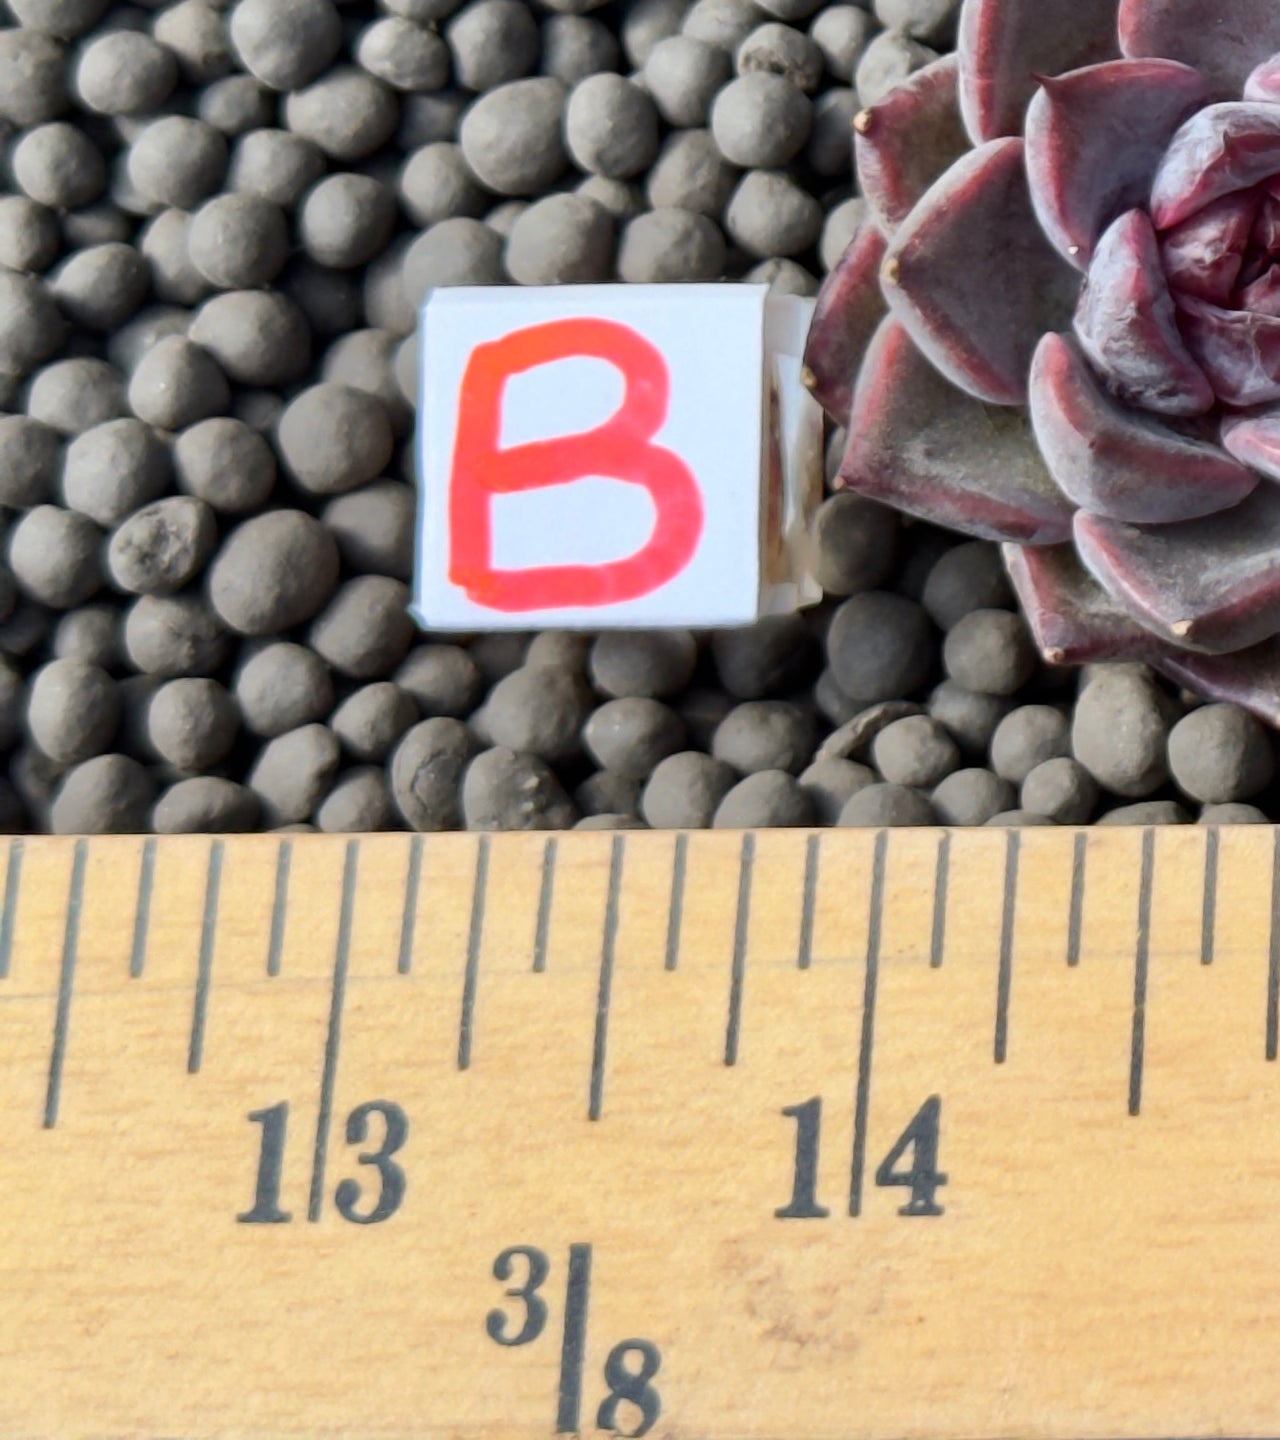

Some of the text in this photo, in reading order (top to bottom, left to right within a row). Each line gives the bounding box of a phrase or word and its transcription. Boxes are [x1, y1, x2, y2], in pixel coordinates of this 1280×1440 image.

[447, 316, 702, 613] B
[236, 1098, 409, 1226] 13
[773, 1094, 948, 1220] 14
